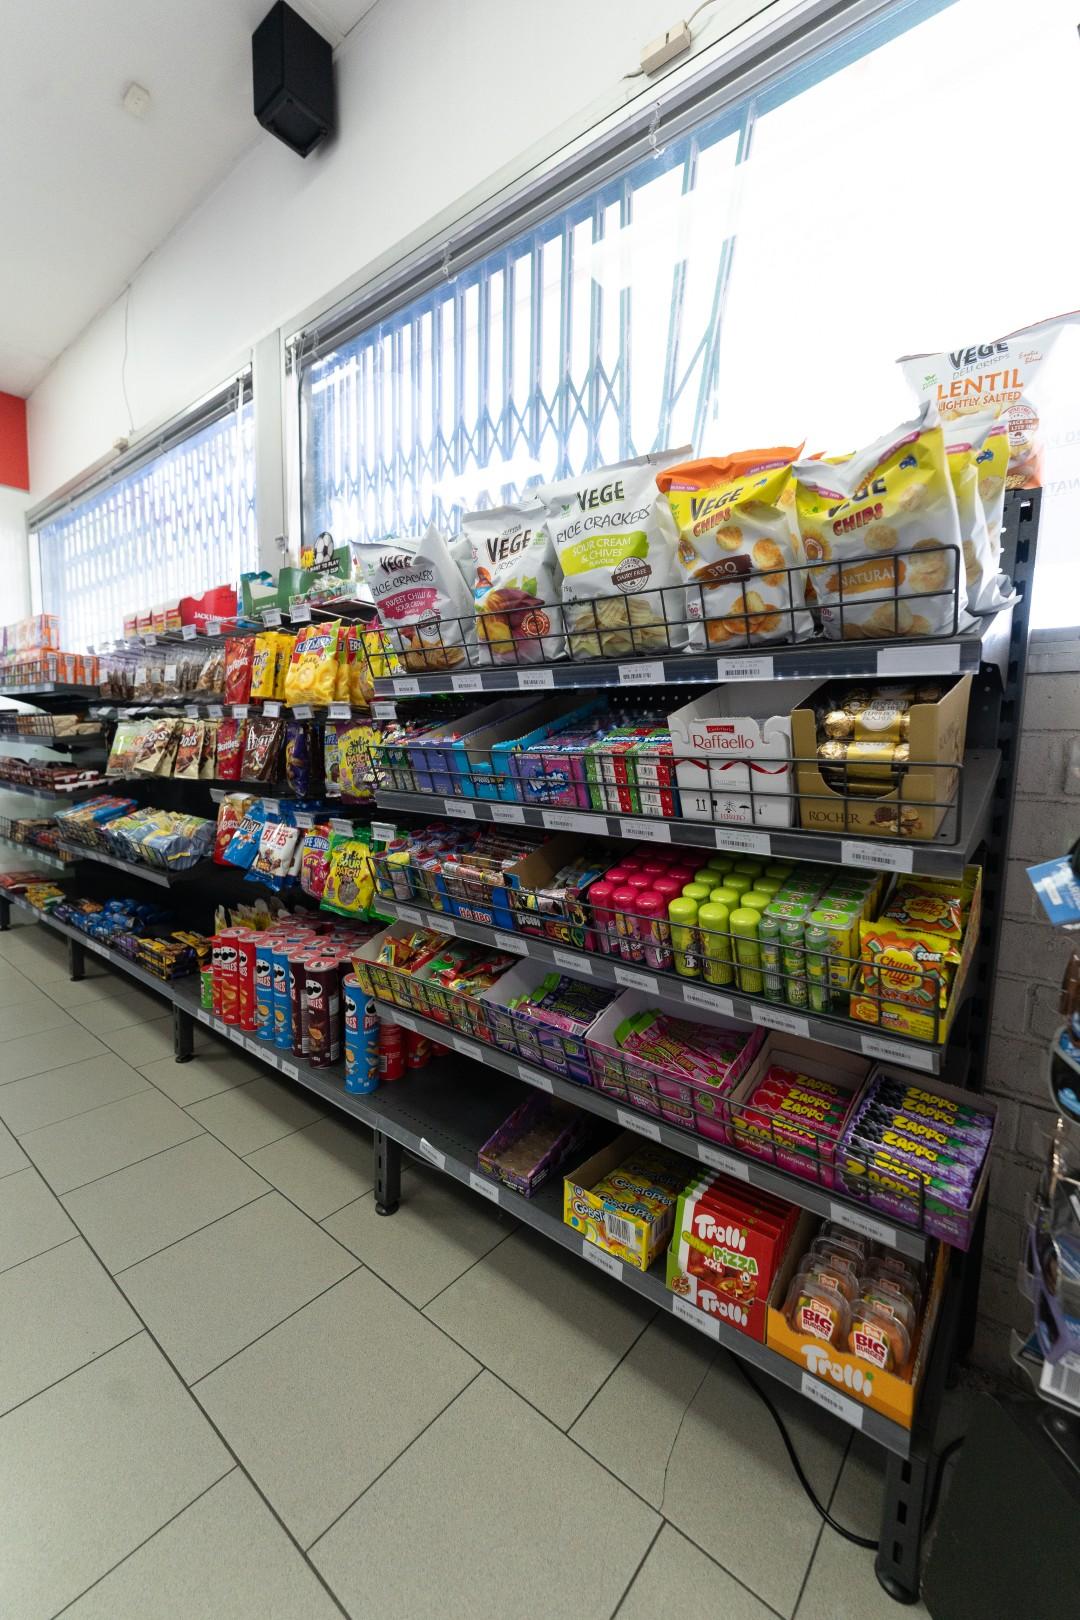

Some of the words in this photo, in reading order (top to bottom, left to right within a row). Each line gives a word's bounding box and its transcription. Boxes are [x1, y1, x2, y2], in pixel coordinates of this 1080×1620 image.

[949, 341, 1009, 371] VEGE
[937, 368, 1024, 401] LENTIL
[937, 397, 981, 412] LIGHTLY
[983, 391, 1022, 404] SALTED
[577, 480, 625, 512] VEGE
[691, 487, 744, 521] VEGE
[693, 507, 731, 537] CHIPS
[833, 502, 884, 536] CHIPS
[556, 520, 581, 545] RICE
[487, 529, 532, 563] VEGE
[573, 540, 595, 557] SOUR
[596, 536, 632, 548] CREAM
[589, 548, 623, 561] CHIVES
[633, 568, 648, 577] FREE
[708, 561, 738, 577] BBQ
[841, 565, 896, 588] NATURAL
[385, 594, 407, 609] SWEET
[692, 734, 755, 751] Raffaello
[808, 809, 862, 825] ROCHER
[458, 906, 493, 924] HARIBO
[916, 952, 942, 962] SOUR
[781, 1098, 825, 1121] ZAPPO
[788, 1087, 832, 1110] ZAPPO
[907, 1086, 959, 1113] ZAPPO
[902, 1099, 956, 1125] ZAPPO
[893, 1114, 948, 1144] ZAPPO
[882, 1130, 938, 1161] ZAPPO
[694, 1214, 748, 1251] Trolli
[703, 1256, 723, 1272] XXL
[713, 1245, 759, 1276] PIZZA
[698, 1289, 748, 1327] Trolli
[802, 1309, 833, 1333] BIG
[855, 1333, 886, 1357] BIG
[801, 1344, 875, 1398] Trolli
